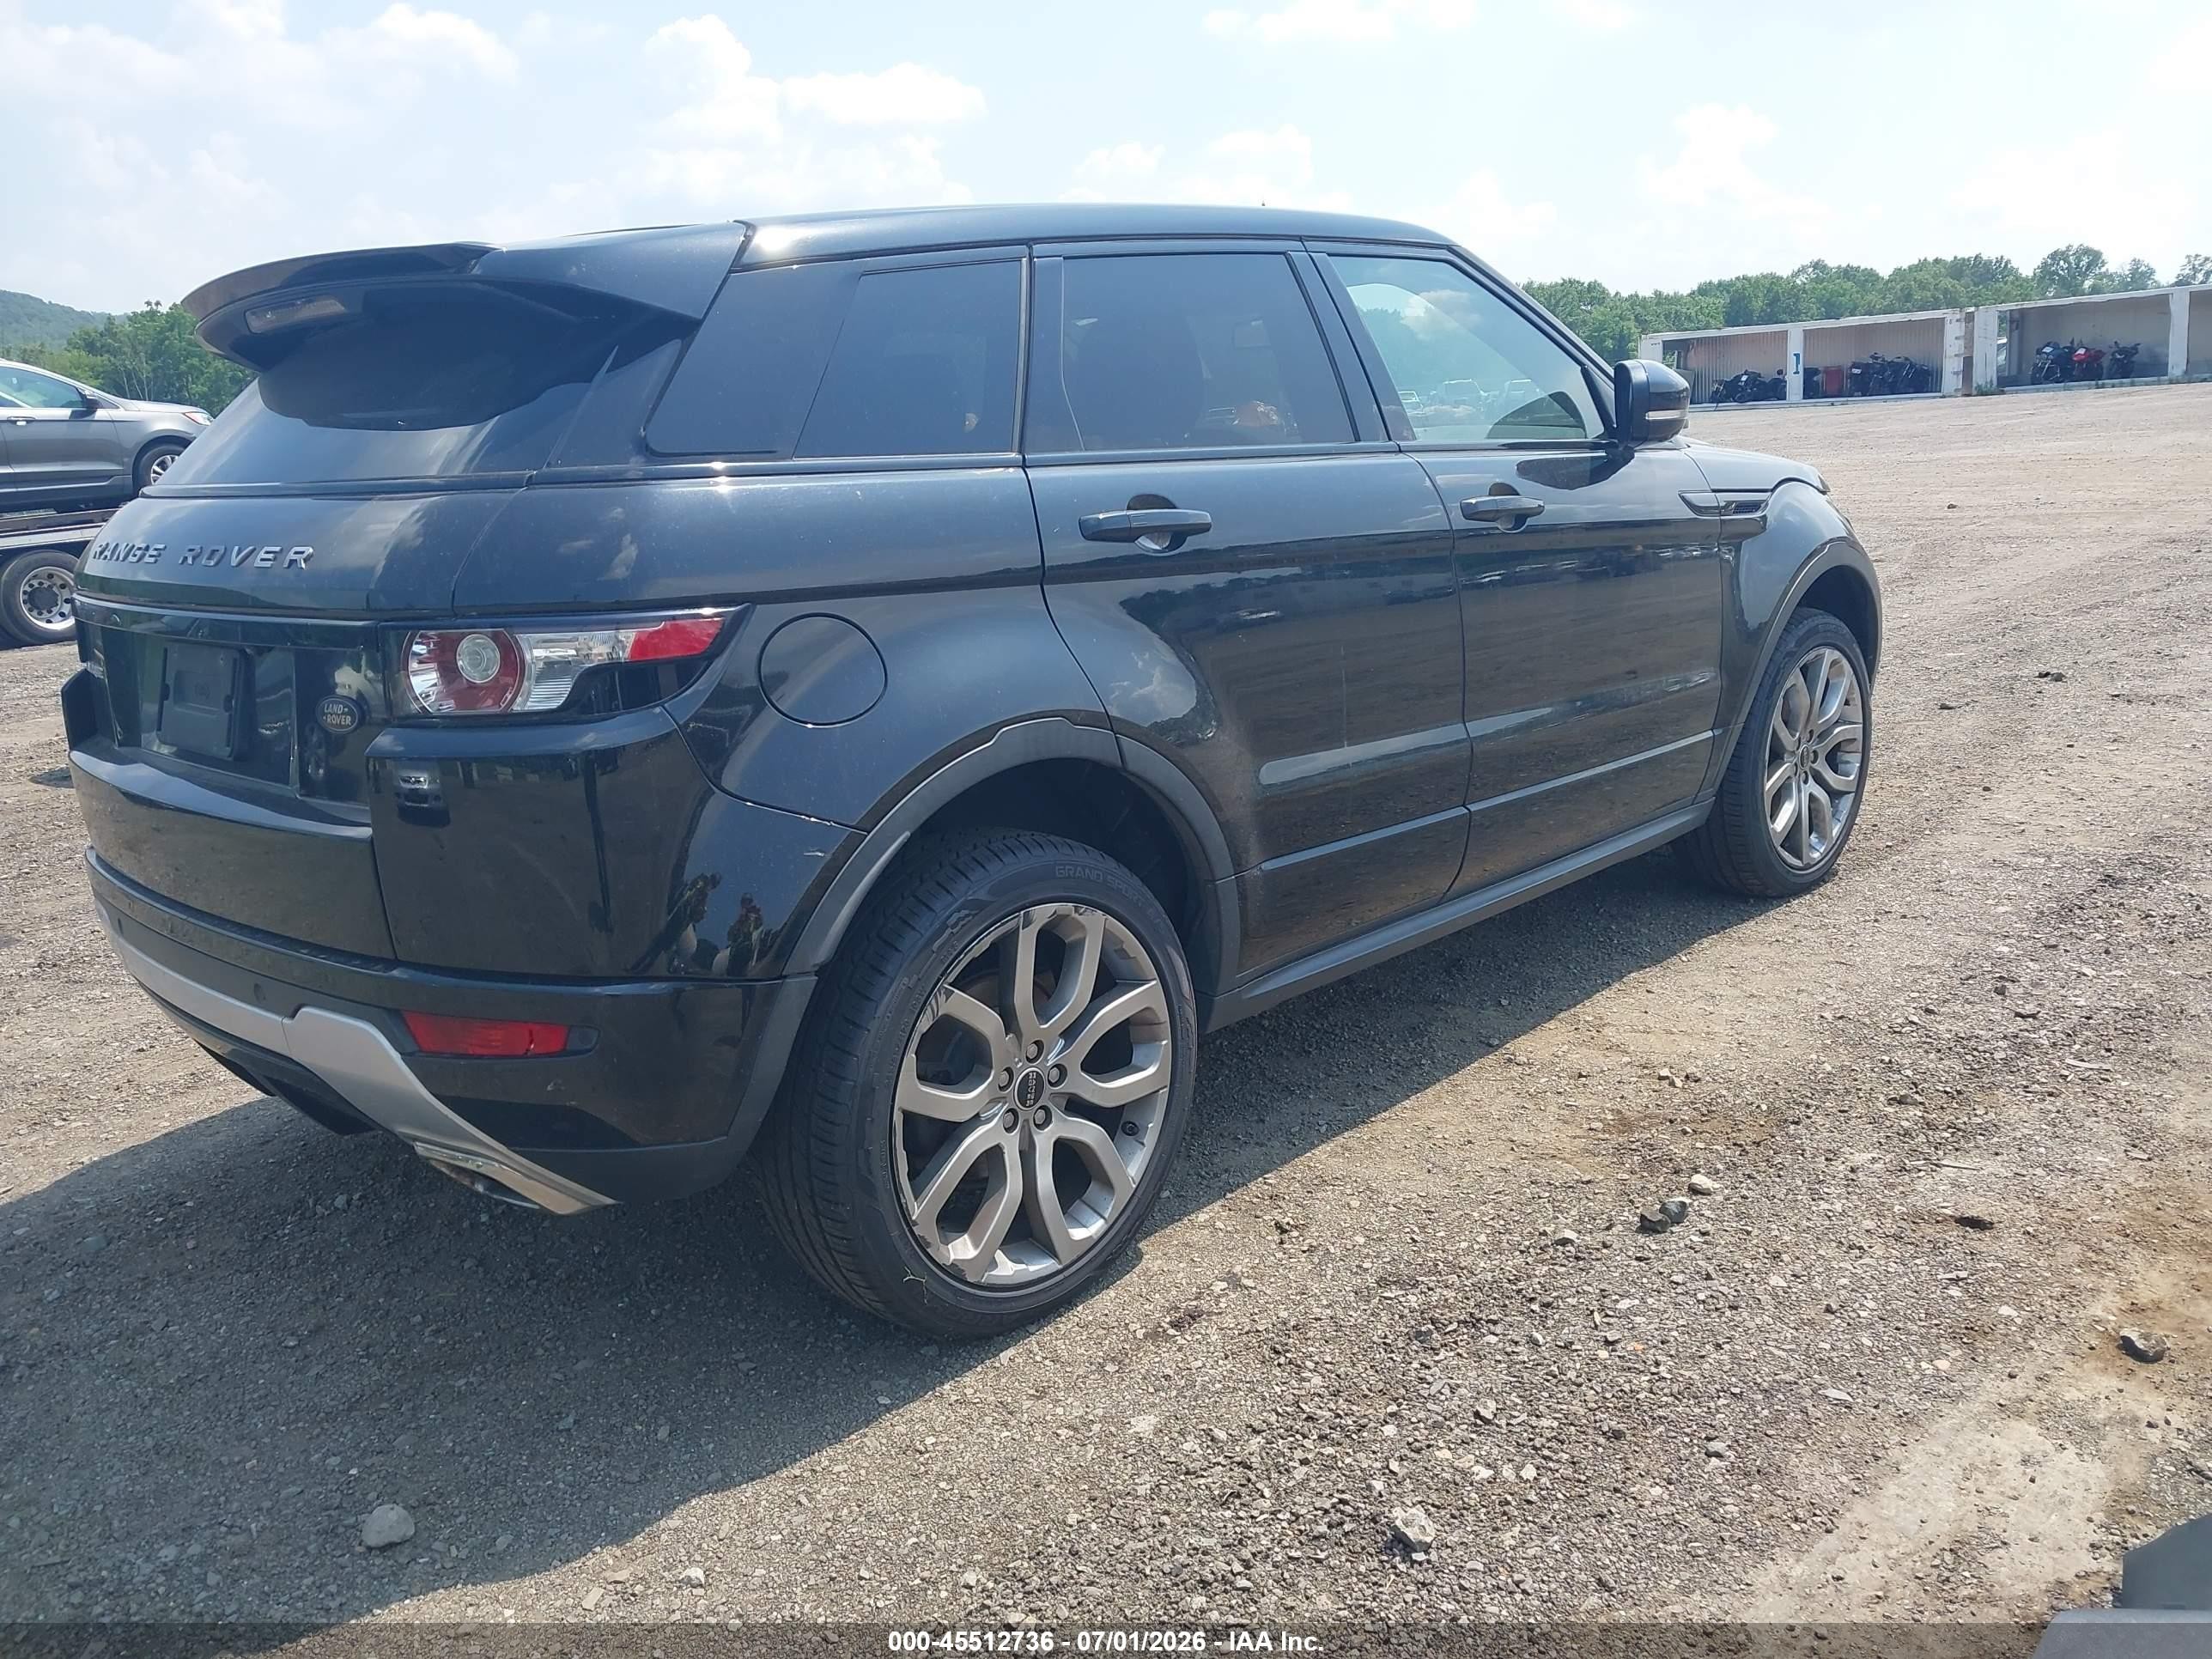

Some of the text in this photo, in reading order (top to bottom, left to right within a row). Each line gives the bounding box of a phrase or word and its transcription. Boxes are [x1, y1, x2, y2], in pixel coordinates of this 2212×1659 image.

[91, 542, 314, 570] RANGE ROVER
[324, 703, 343, 714] LAND
[326, 714, 351, 726] ROVER
[1055, 866, 1103, 881] GRAND
